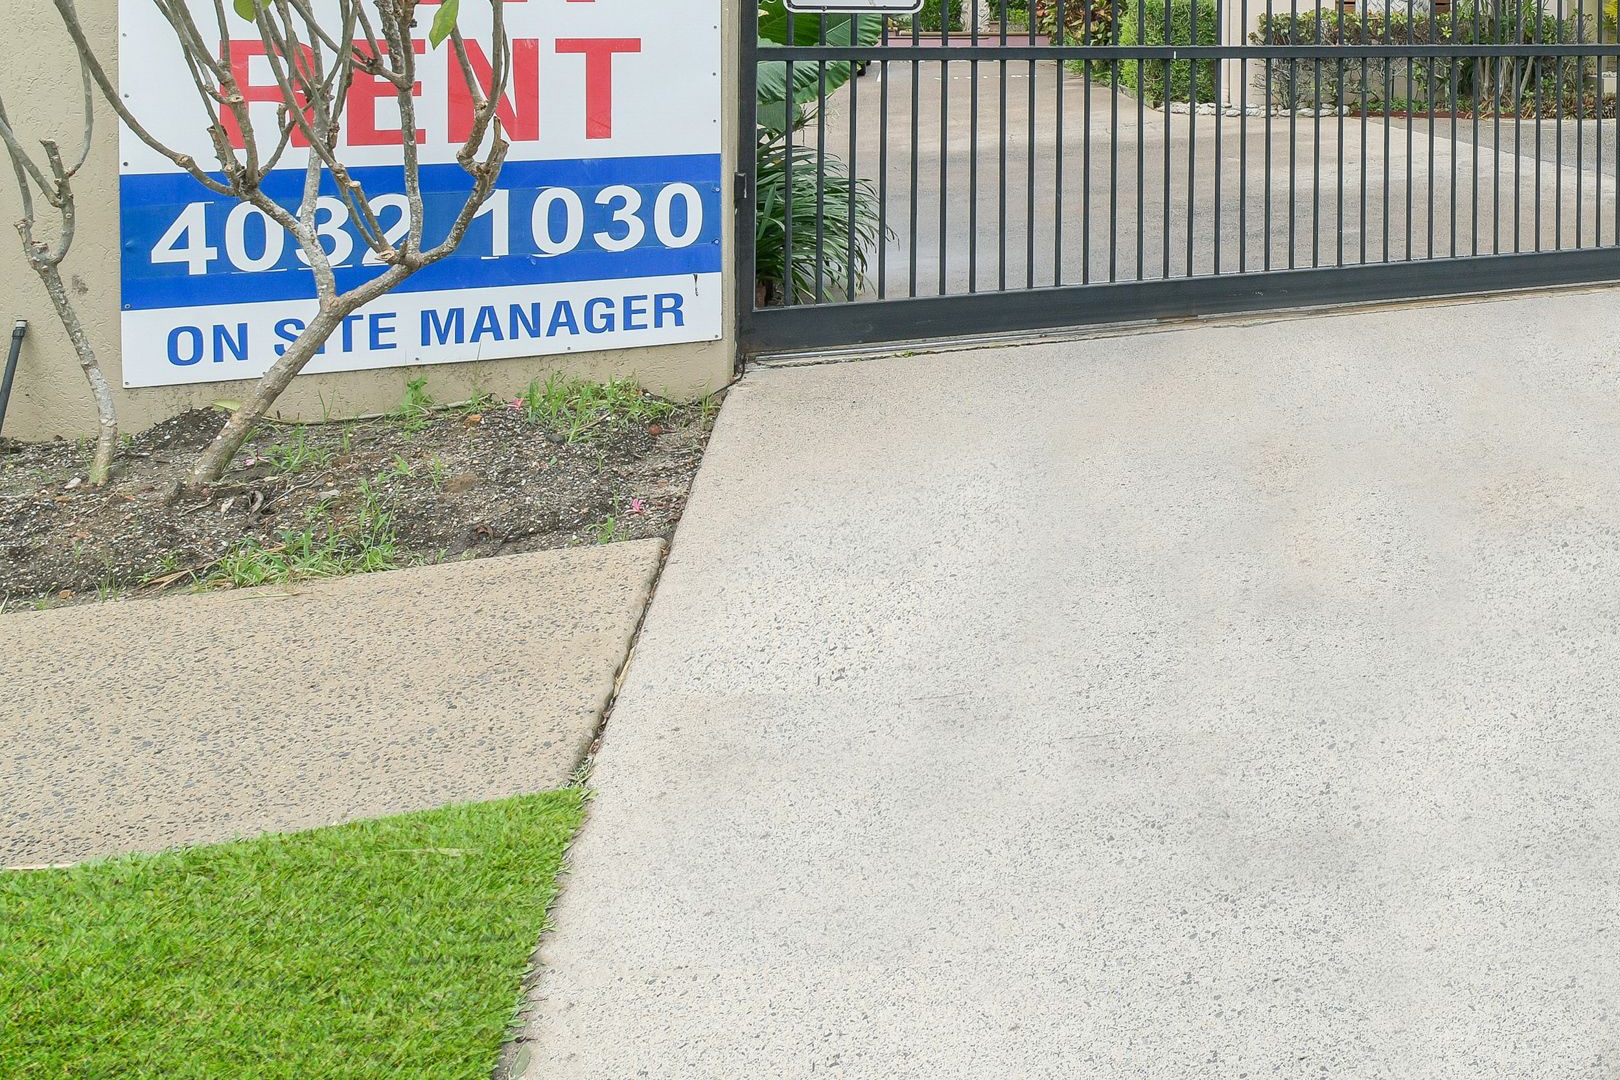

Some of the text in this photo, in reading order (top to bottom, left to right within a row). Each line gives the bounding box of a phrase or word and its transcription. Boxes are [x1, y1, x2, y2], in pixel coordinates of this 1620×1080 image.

[219, 37, 642, 150] RENT
[150, 183, 704, 276] 4032 1030
[166, 292, 686, 366] ON STE MANAGER
